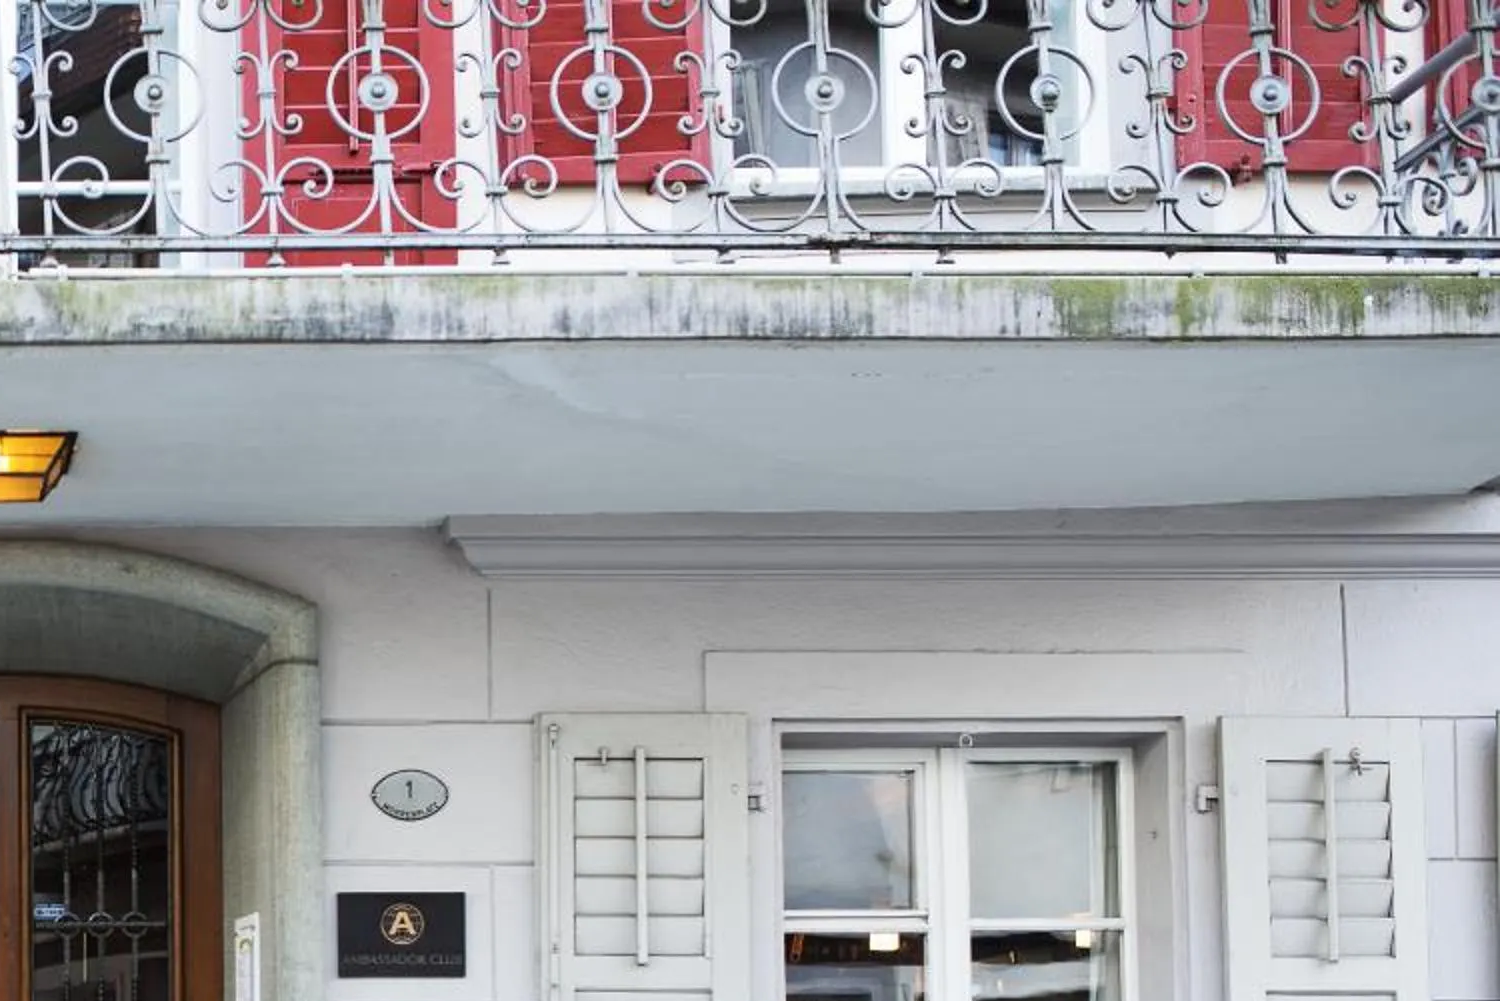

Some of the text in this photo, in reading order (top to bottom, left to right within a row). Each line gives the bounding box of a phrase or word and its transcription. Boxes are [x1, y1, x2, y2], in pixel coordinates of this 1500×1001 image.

[405, 780, 413, 798] 1
[388, 910, 417, 935] A
[343, 953, 427, 965] AMBASSADOR
